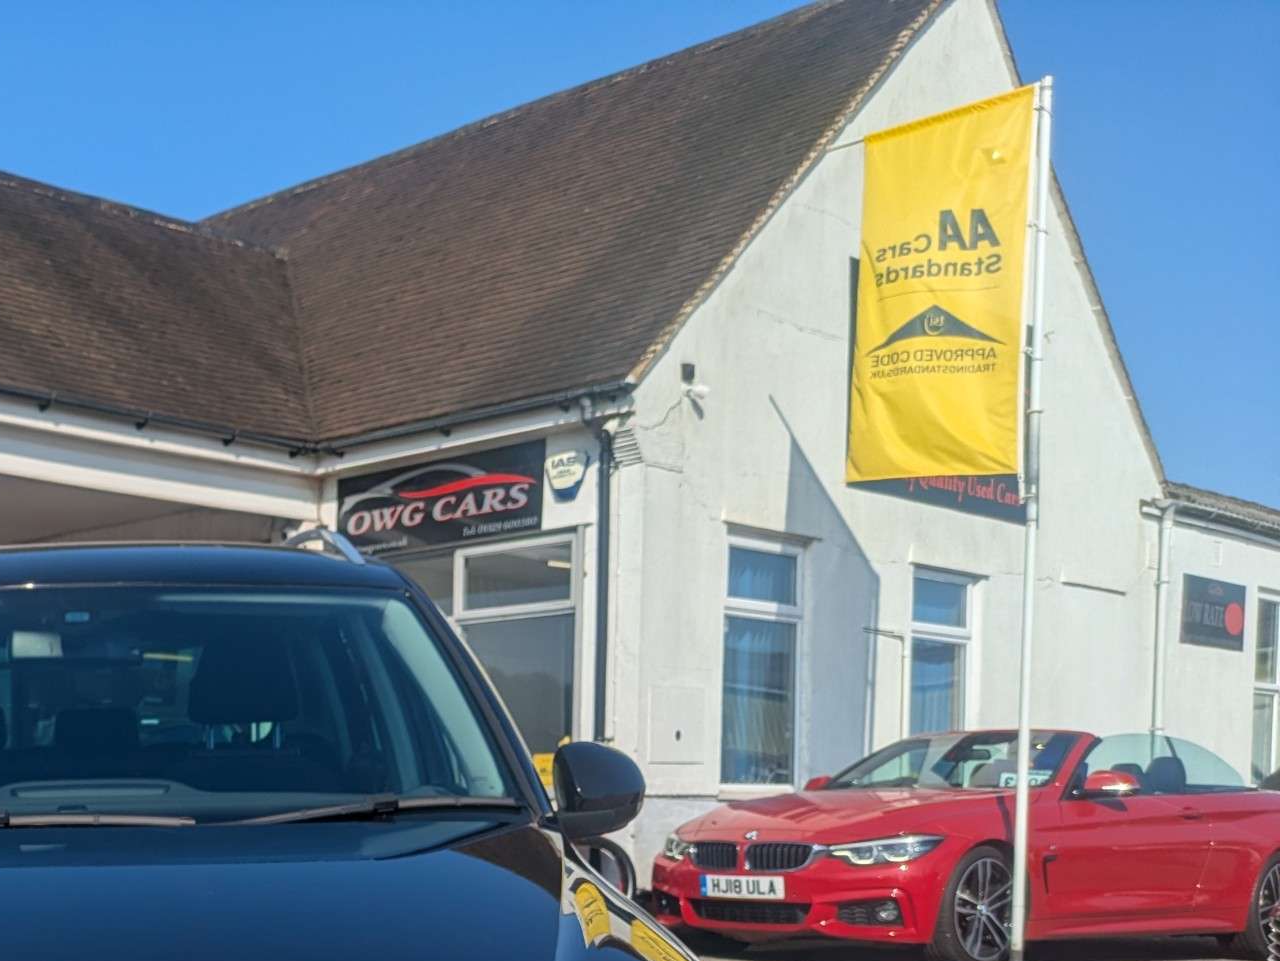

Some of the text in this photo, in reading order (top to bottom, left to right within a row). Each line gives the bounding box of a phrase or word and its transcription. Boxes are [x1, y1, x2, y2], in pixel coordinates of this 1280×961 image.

[967, 477, 994, 499] Used
[347, 502, 425, 537] OWG
[431, 483, 530, 522] CARS
[711, 878, 777, 896] HJ18 ULA
